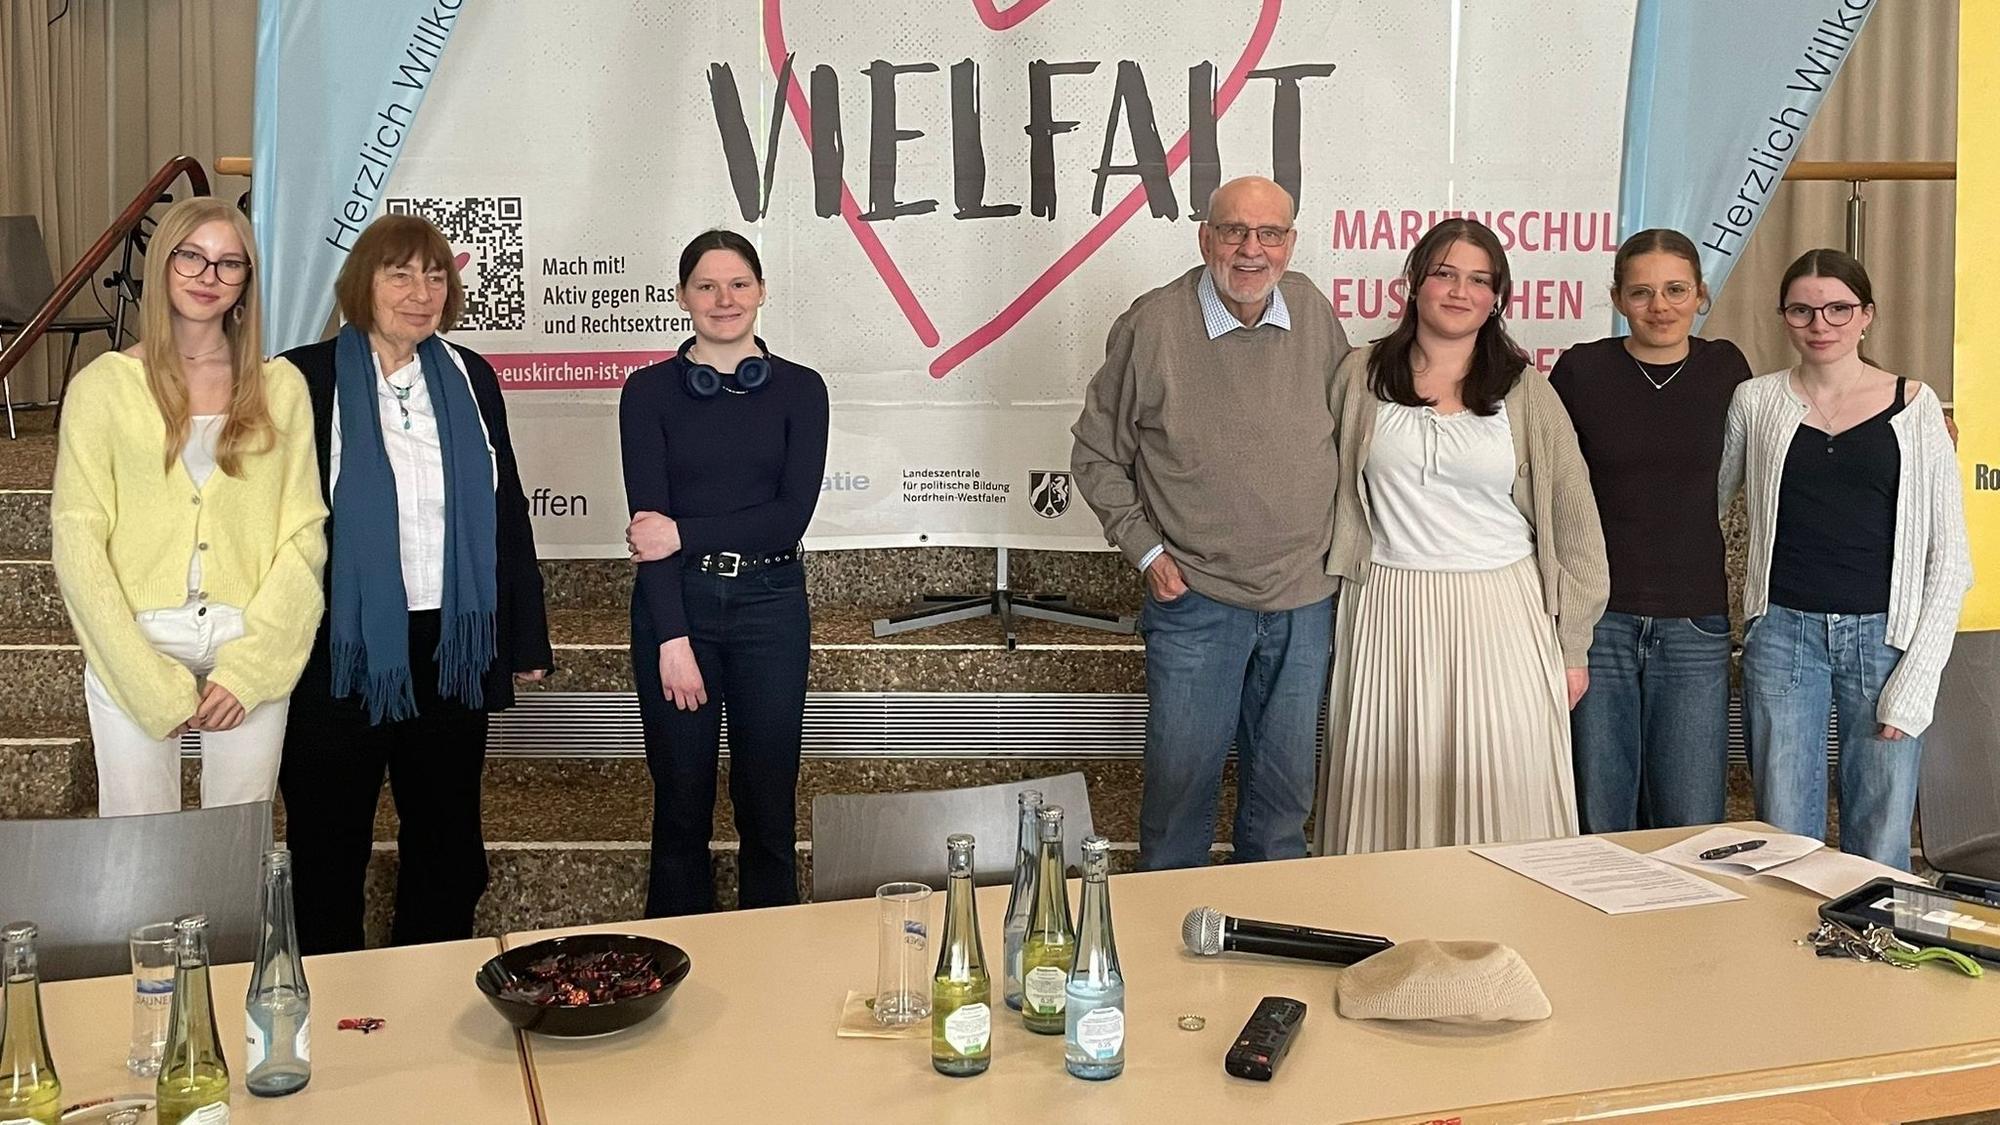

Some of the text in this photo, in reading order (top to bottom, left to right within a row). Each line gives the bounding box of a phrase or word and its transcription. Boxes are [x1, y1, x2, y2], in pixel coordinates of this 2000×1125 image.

[326, 102, 412, 252] Herzlich
[1702, 107, 1808, 256] Herzlich
[543, 256, 625, 275] Mach mit!
[543, 285, 587, 304] Aktiv
[592, 288, 640, 309] gegen
[544, 315, 576, 333] und
[903, 469, 981, 478] Landeszentrale
[903, 480, 1010, 493] für politische Bildung
[903, 493, 1006, 503] Nordrhein-Westfalen
